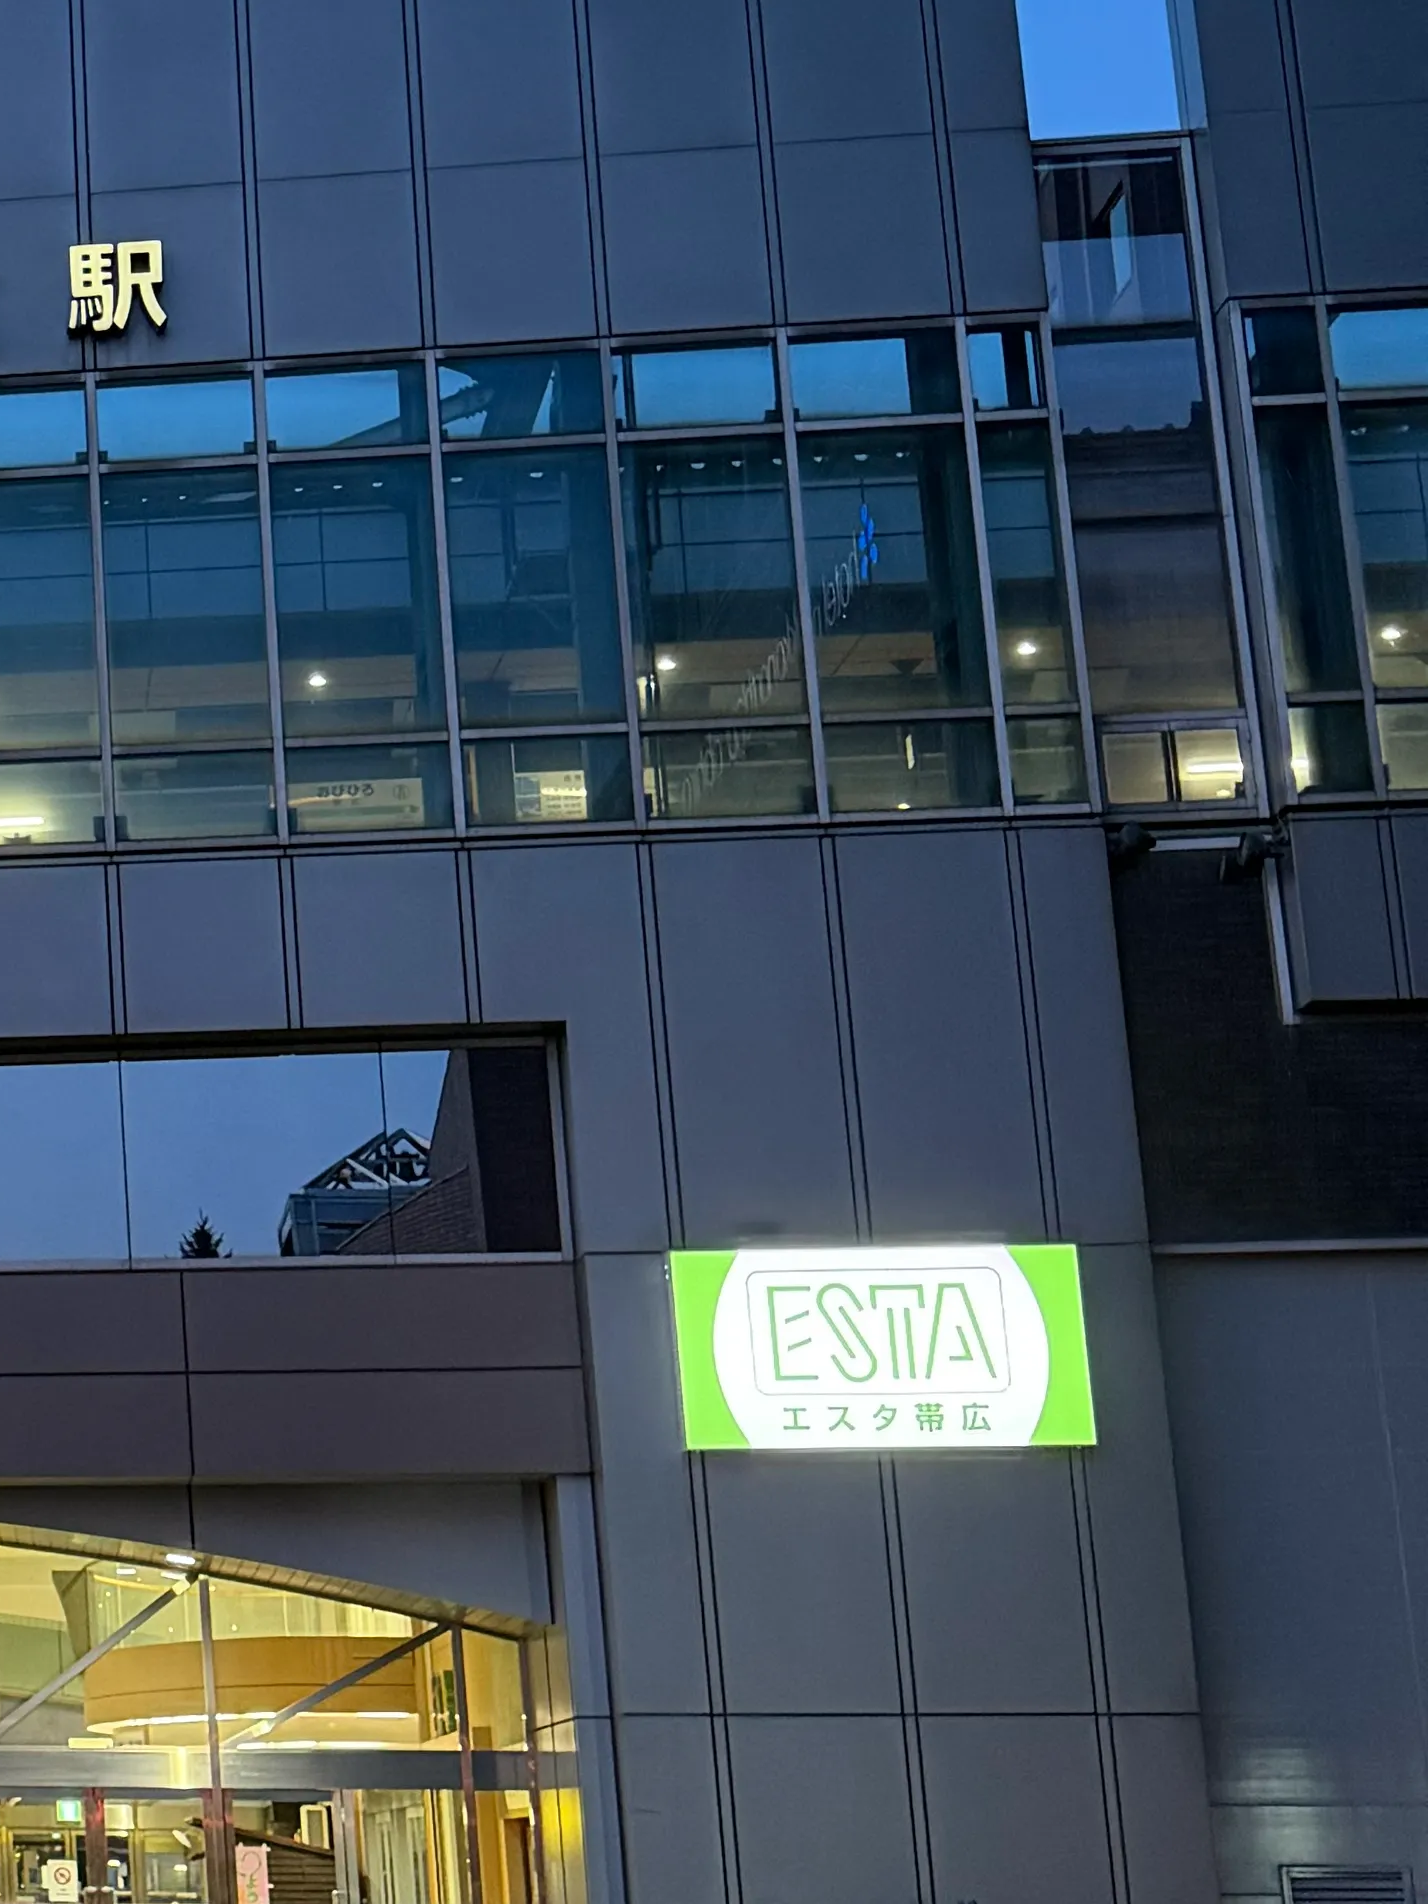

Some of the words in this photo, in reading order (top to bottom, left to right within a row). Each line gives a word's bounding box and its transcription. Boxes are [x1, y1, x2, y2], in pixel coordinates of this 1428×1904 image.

[766, 1282, 997, 1383] ESTA
[782, 1401, 992, 1433] エスタ帯広
